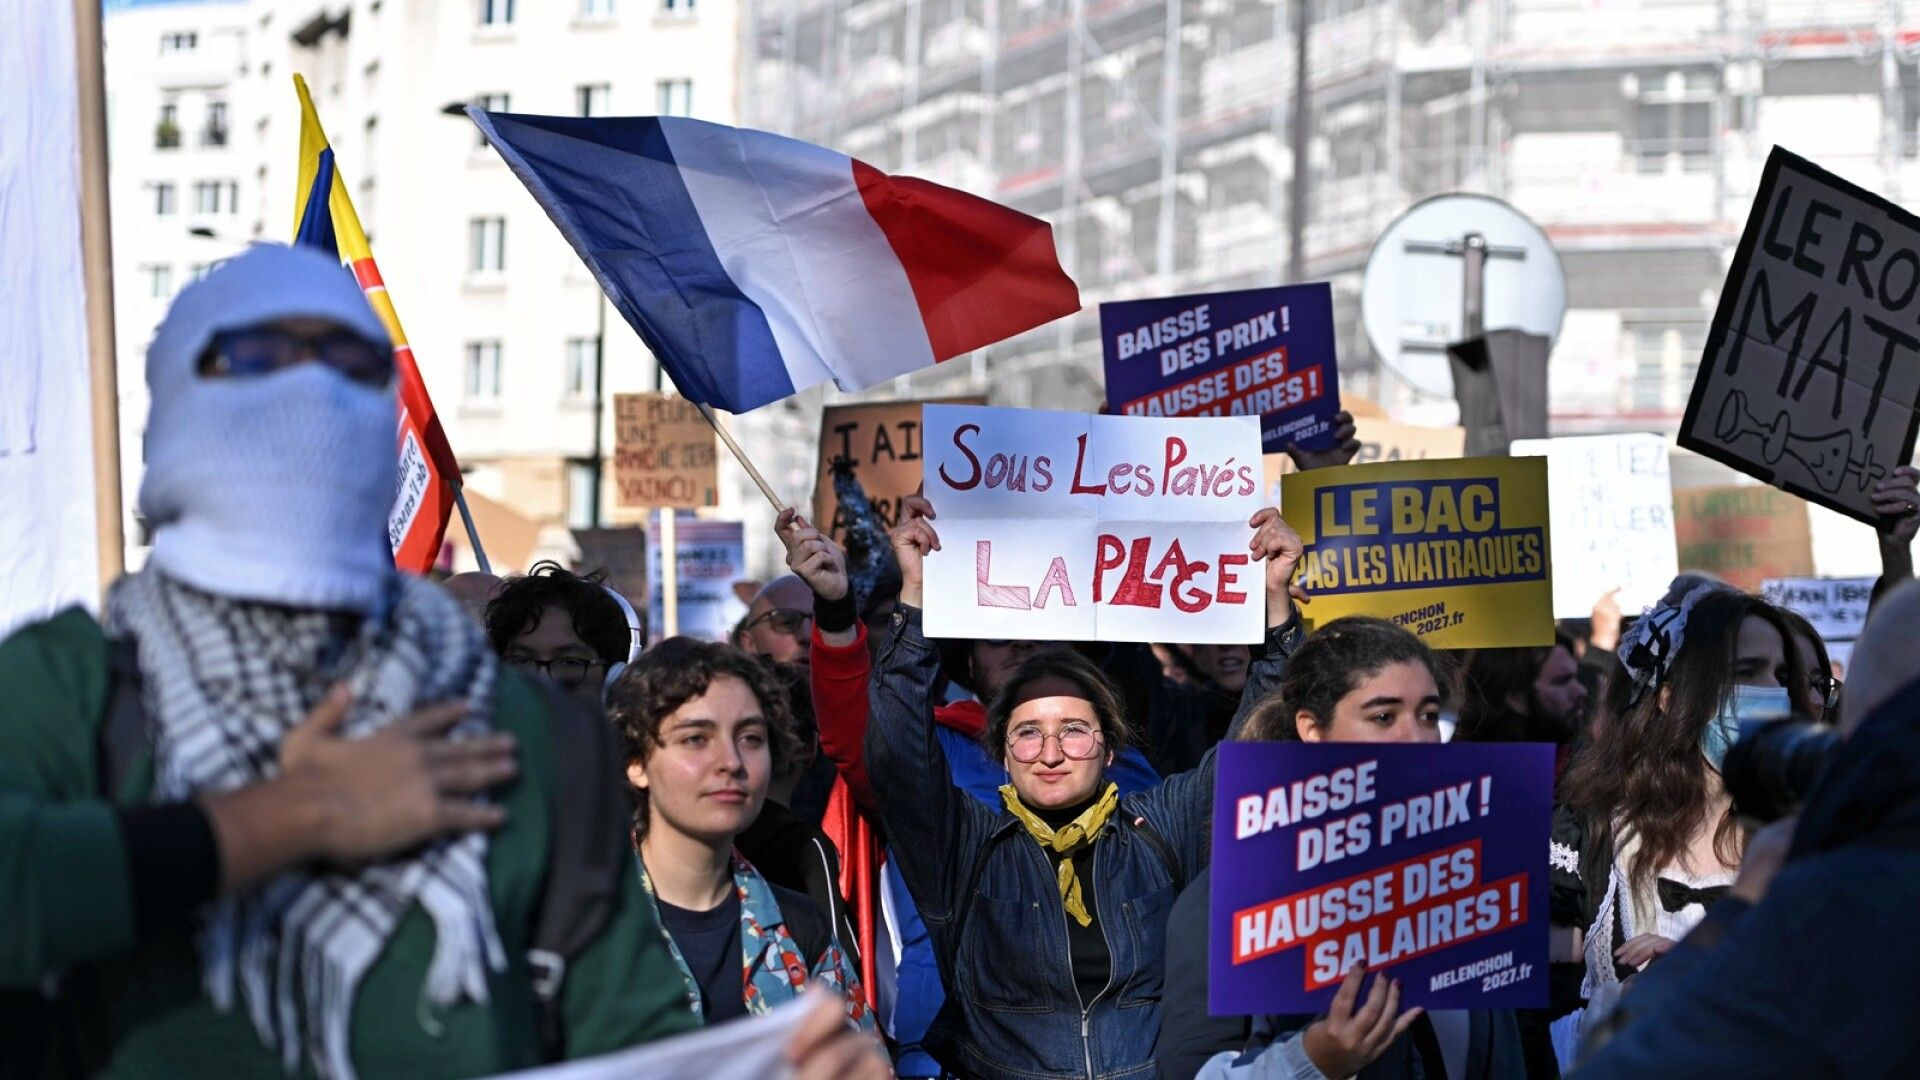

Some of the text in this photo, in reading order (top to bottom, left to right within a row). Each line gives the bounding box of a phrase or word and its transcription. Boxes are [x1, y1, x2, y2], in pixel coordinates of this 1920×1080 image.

[1762, 184, 1920, 314] LE RO
[1117, 303, 1212, 360] BAISSE
[1160, 336, 1212, 377] DES
[1215, 310, 1277, 357] PRIX
[1724, 267, 1920, 440] MAT
[1126, 351, 1284, 417] HAUSSE DES
[1197, 376, 1304, 417] AIRES
[871, 420, 923, 464] AI
[938, 423, 1256, 498] Sous Les Pavés
[1295, 421, 1330, 442] 2027.fr
[1321, 484, 1496, 537] LE BAC
[1092, 533, 1249, 613] PLAGE
[1295, 533, 1542, 590] PAS LES MATRAQUES
[1388, 602, 1446, 626] ENCHON
[1416, 610, 1465, 636] 2027.fr
[1236, 760, 1378, 841] BAISSE
[1297, 776, 1492, 872] DES PRIX !
[1239, 848, 1475, 957] HAUSSE DES
[1313, 881, 1520, 983] SALAIRES !
[1430, 952, 1514, 992] MELENCHON
[1481, 964, 1533, 993] 2027.fr
